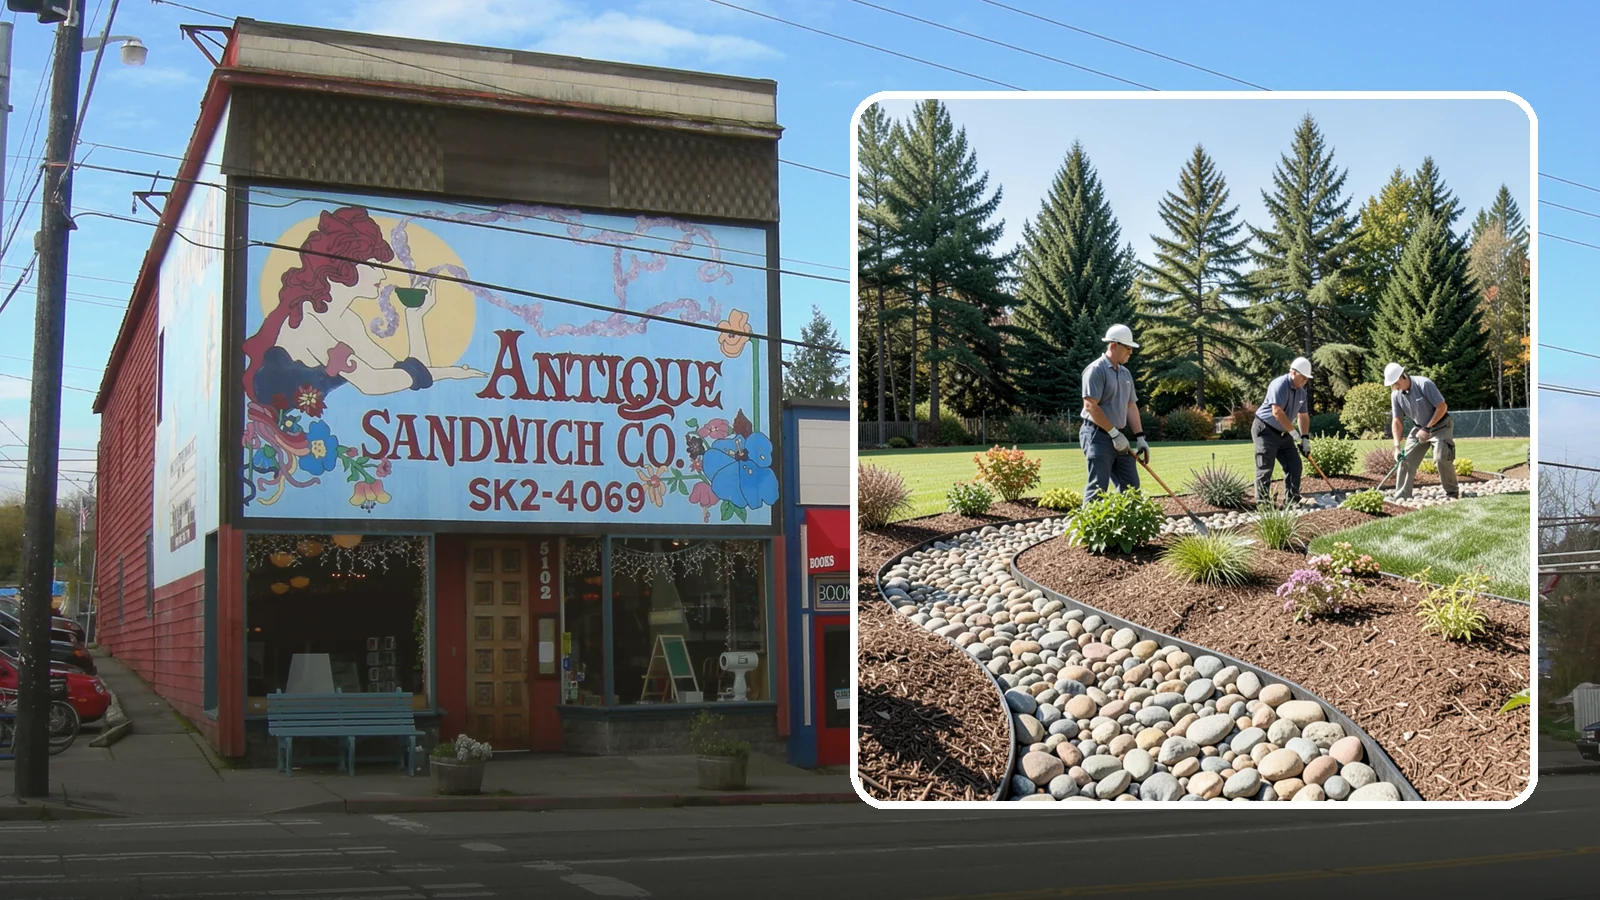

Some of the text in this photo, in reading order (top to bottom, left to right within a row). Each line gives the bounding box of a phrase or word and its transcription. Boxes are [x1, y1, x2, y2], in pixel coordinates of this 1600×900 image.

[476, 328, 723, 421] ANTIQUE
[361, 408, 685, 469] SANDWICH CO.
[468, 477, 645, 513] SK2-4069
[539, 541, 552, 599] 5102
[809, 555, 835, 569] BOOKS
